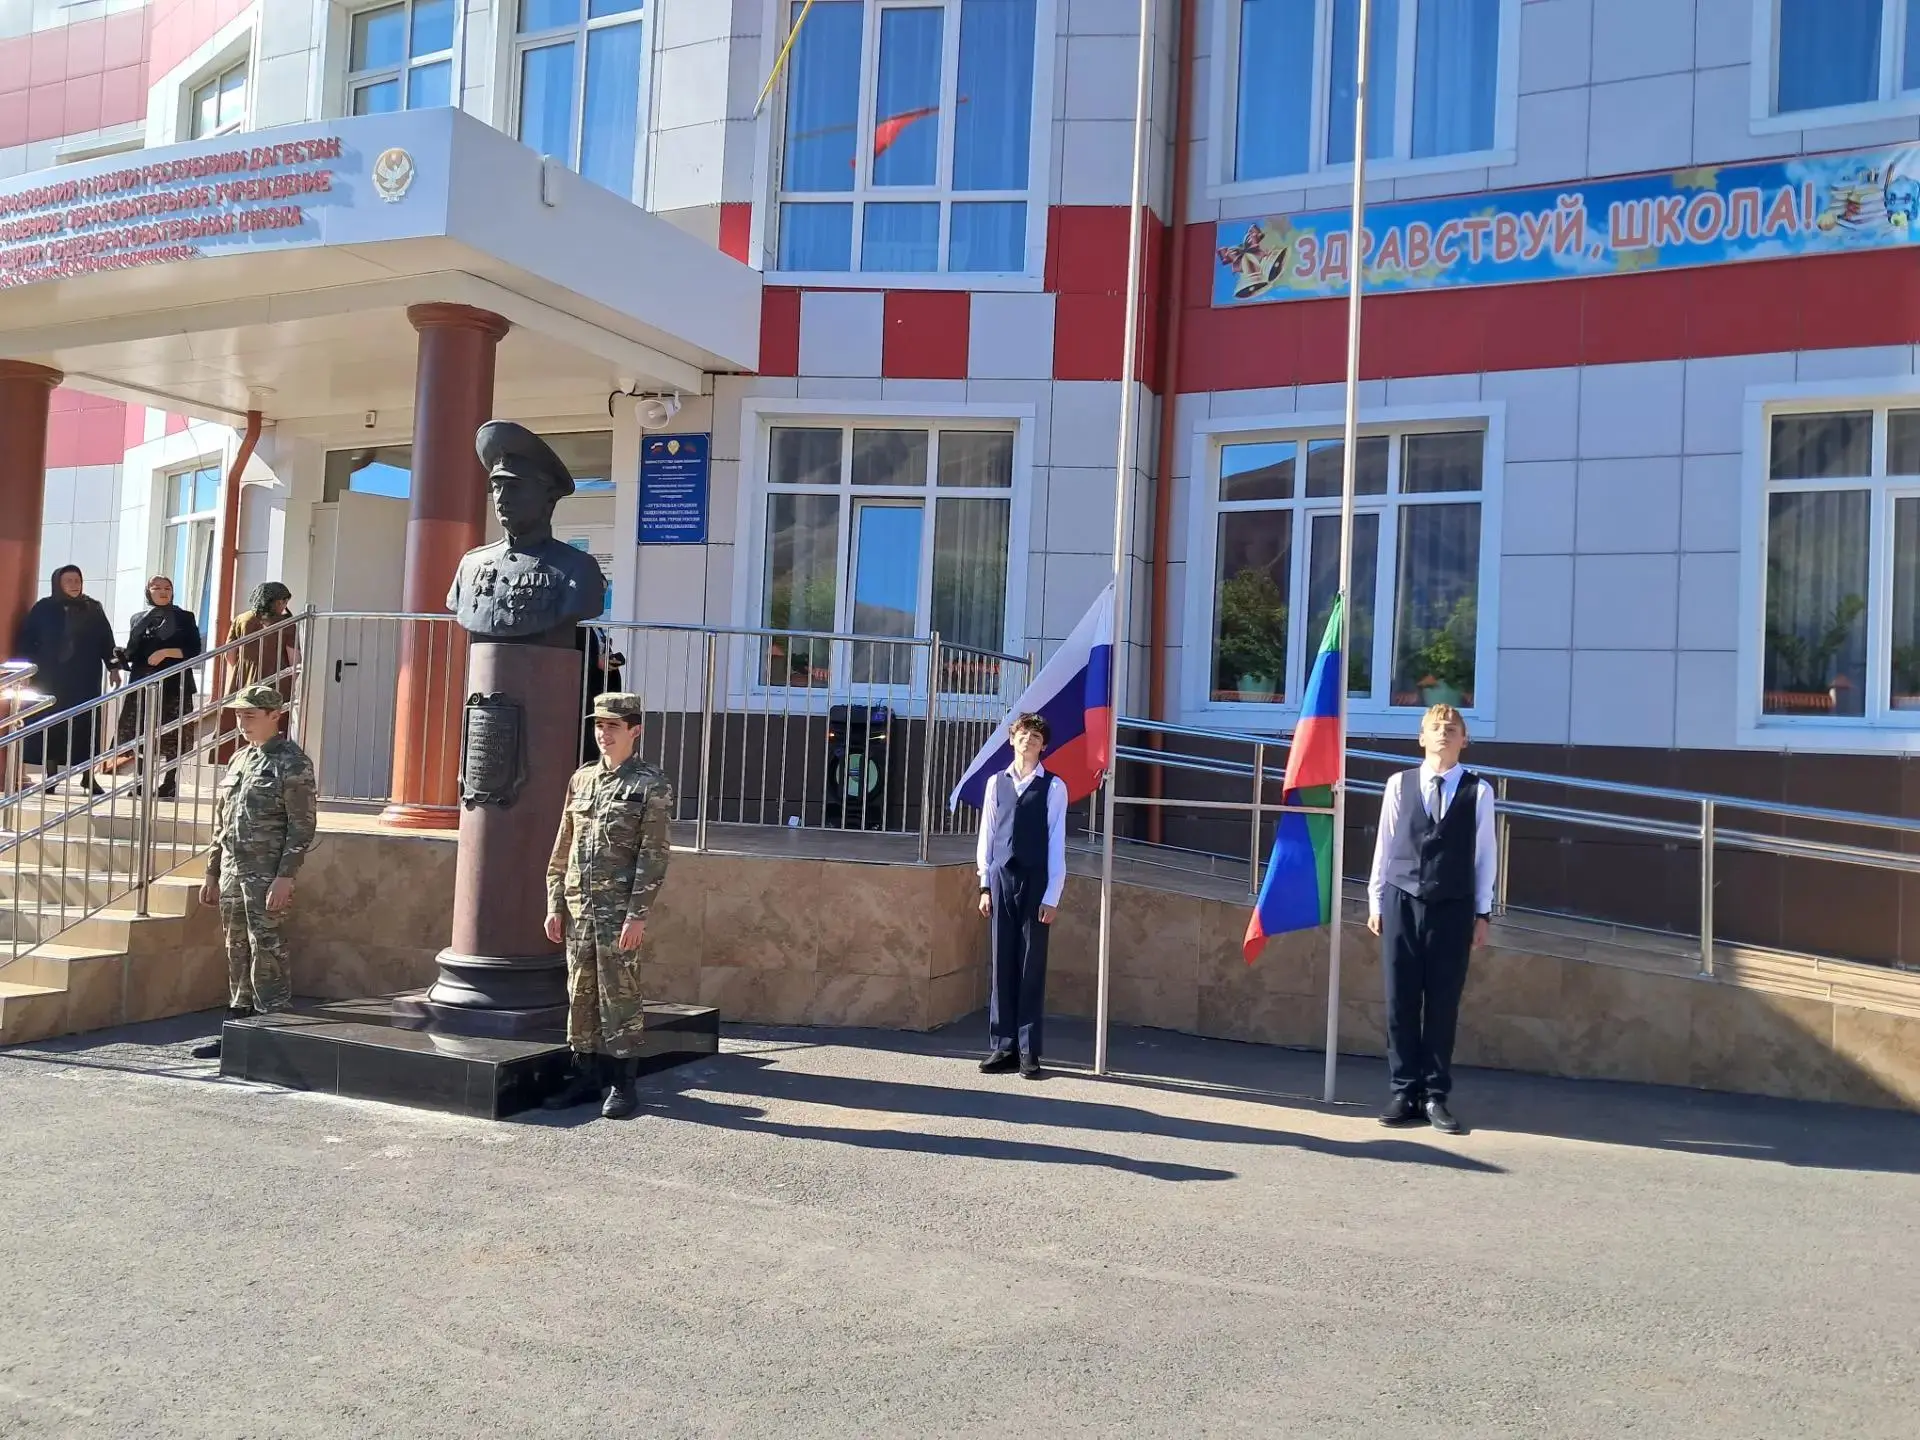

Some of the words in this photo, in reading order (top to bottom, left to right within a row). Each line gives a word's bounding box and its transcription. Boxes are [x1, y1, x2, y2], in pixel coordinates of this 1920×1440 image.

[94, 167, 142, 193] НАУКИ
[142, 151, 247, 186] РЕСПУБЛИКИ
[248, 136, 341, 171] ДАГЕСТАН
[66, 186, 213, 229] ОБРАЗОВАТЕЛЬНОЕ
[214, 170, 333, 206] УЧРЕЖДЕНИЕ
[1610, 181, 1814, 248] ШКОЛА!
[46, 213, 236, 261] ОБЩЕОБРАЗОВАТЕЛЬНАЯ
[239, 205, 303, 232] ШКОЛА
